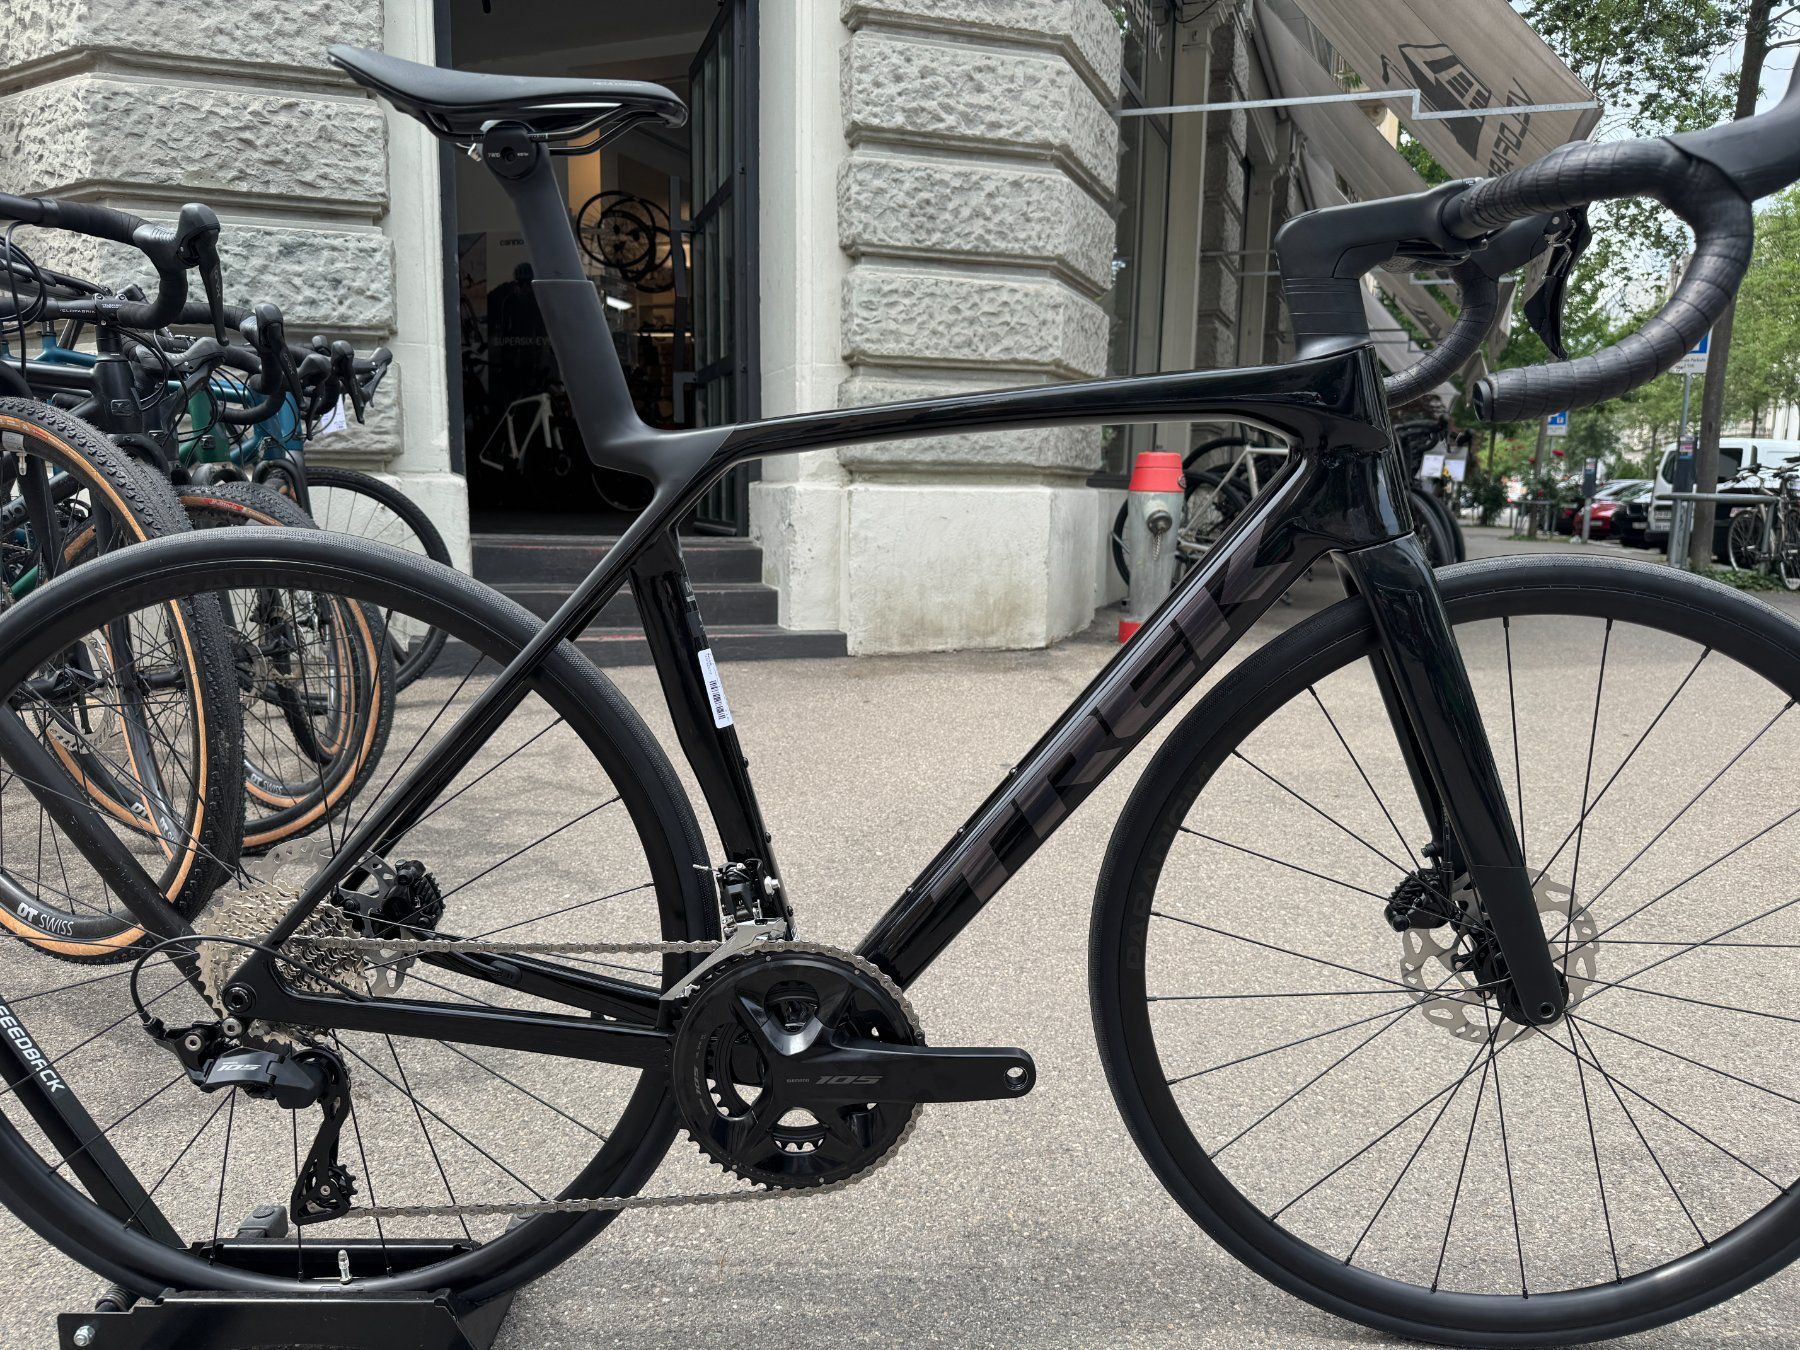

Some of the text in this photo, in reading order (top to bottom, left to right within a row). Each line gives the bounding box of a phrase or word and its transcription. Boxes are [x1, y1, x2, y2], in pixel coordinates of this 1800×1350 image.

[930, 519, 1294, 904] TREK
[17, 902, 75, 936] DT SWISS
[0, 1005, 66, 1094] FEEDBACK
[216, 1064, 262, 1072] 105
[815, 1075, 884, 1085] 105
